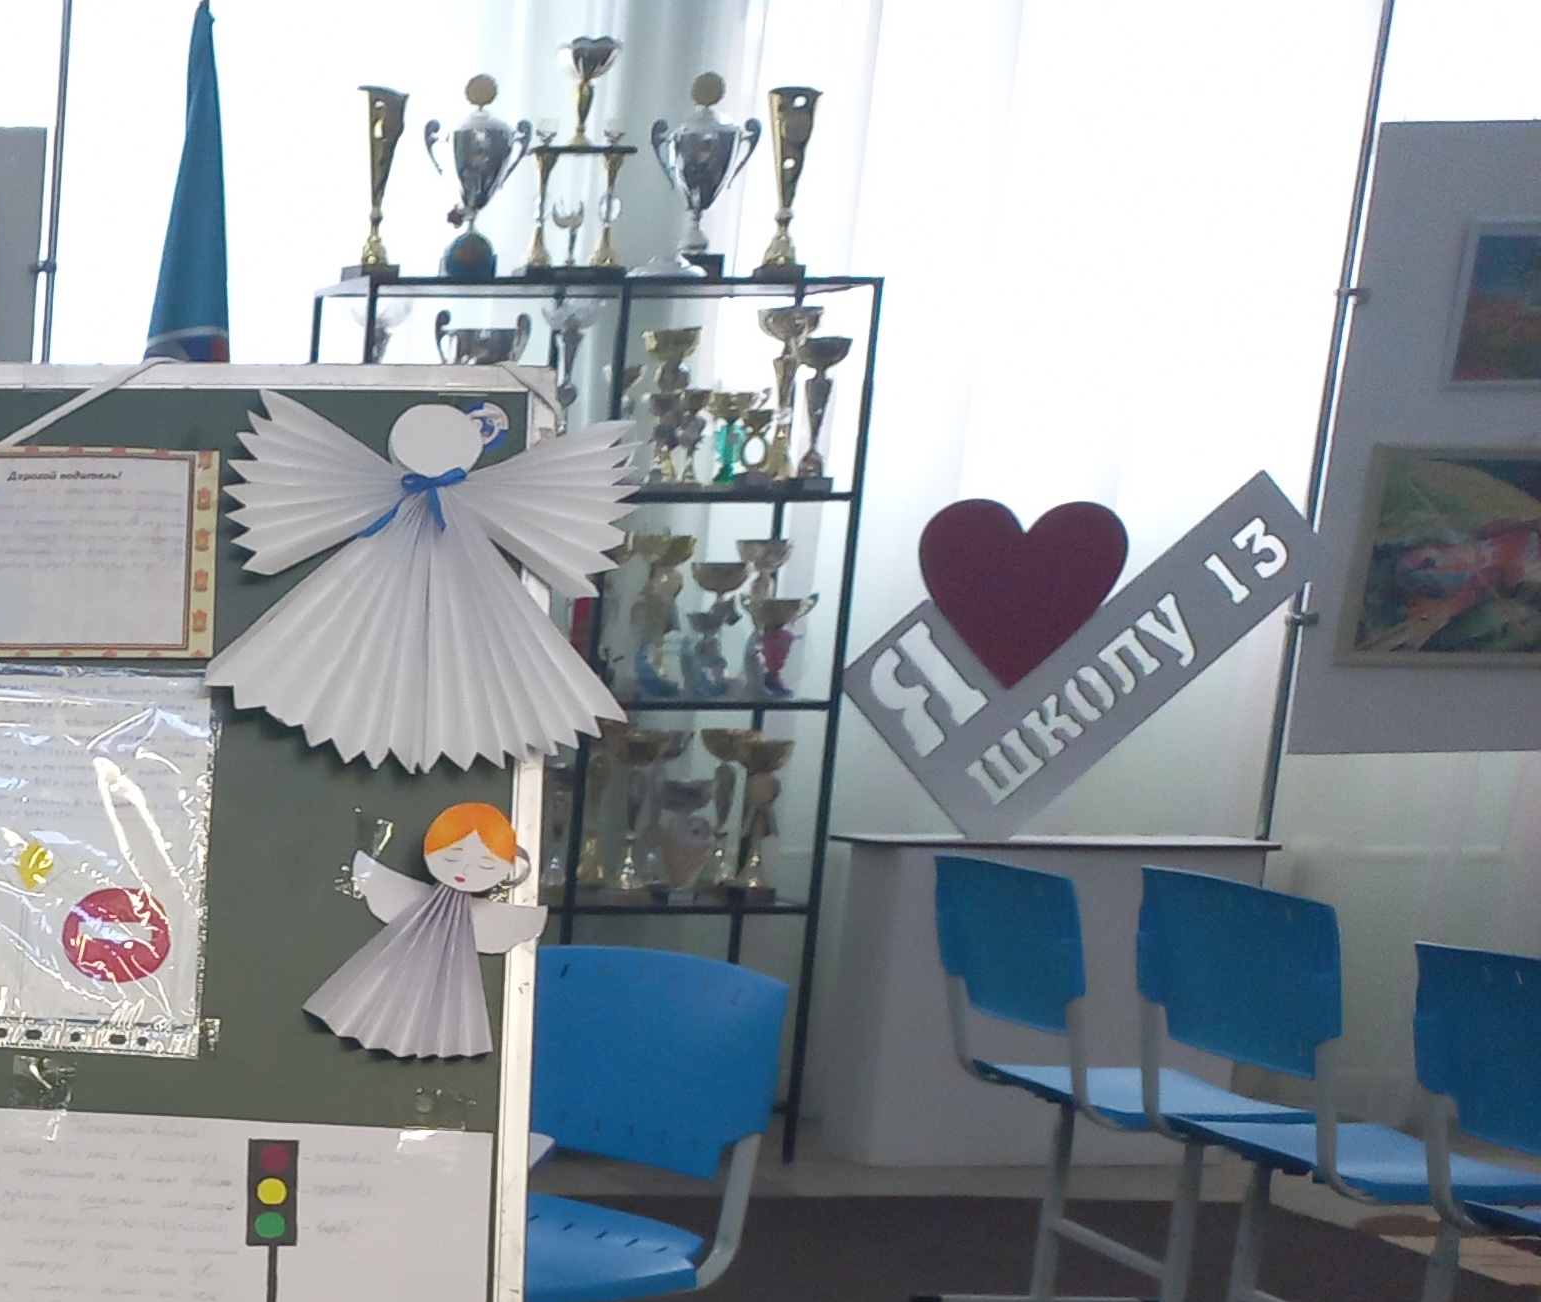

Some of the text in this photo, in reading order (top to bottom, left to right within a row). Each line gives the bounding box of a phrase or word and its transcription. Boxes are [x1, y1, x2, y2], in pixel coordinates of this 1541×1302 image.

[7, 471, 56, 482] Дорогой
[1203, 516, 1289, 605] 13
[870, 620, 990, 758] Я
